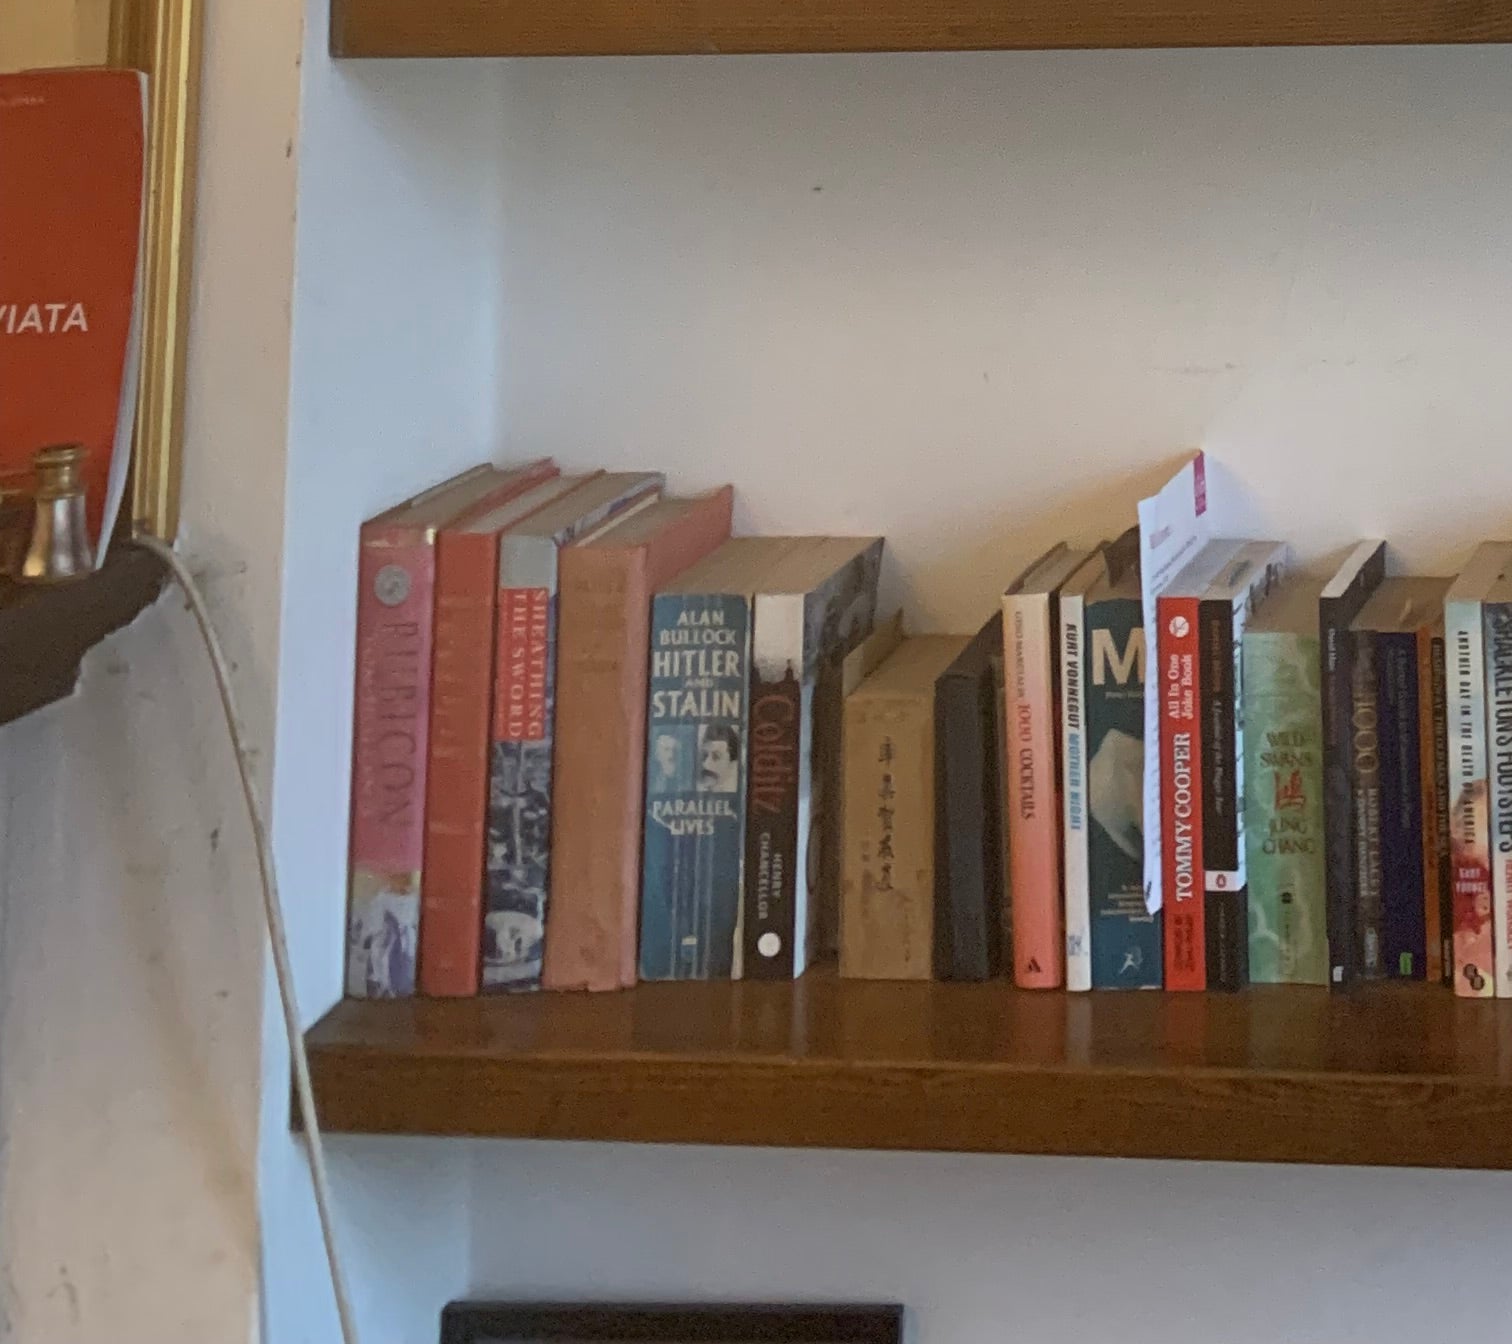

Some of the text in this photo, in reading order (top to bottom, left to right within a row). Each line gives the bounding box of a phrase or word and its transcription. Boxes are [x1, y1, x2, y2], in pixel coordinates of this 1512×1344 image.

[659, 628, 737, 646] BULLOCK
[676, 610, 725, 628] ALAN
[509, 592, 528, 738] THE SWORD
[526, 588, 548, 738] SHEATHING
[653, 649, 741, 678] HITLER
[1457, 630, 1471, 677] ANOTHER
[652, 689, 741, 718] STALIN
[1168, 654, 1181, 719] All In One
[1180, 654, 1194, 720] Joke Book
[1458, 680, 1472, 700] DAY
[379, 622, 420, 827] RUBICON
[1065, 623, 1083, 831] KURT VONNEGUT MOTHER NIGHT
[1459, 705, 1471, 717] IN
[1460, 721, 1472, 740] THE
[752, 694, 795, 814] Colditz
[1016, 703, 1036, 820] 1000 COCKTAILS
[1460, 744, 1473, 778] DEATH
[652, 799, 734, 818] PARALLEL
[669, 817, 715, 836] LIVES
[1174, 732, 1193, 901] TOMMY COOPER
[1463, 800, 1475, 845] AMERICA
[757, 831, 772, 920] CHANCELLOR
[771, 852, 783, 899] HENRY
